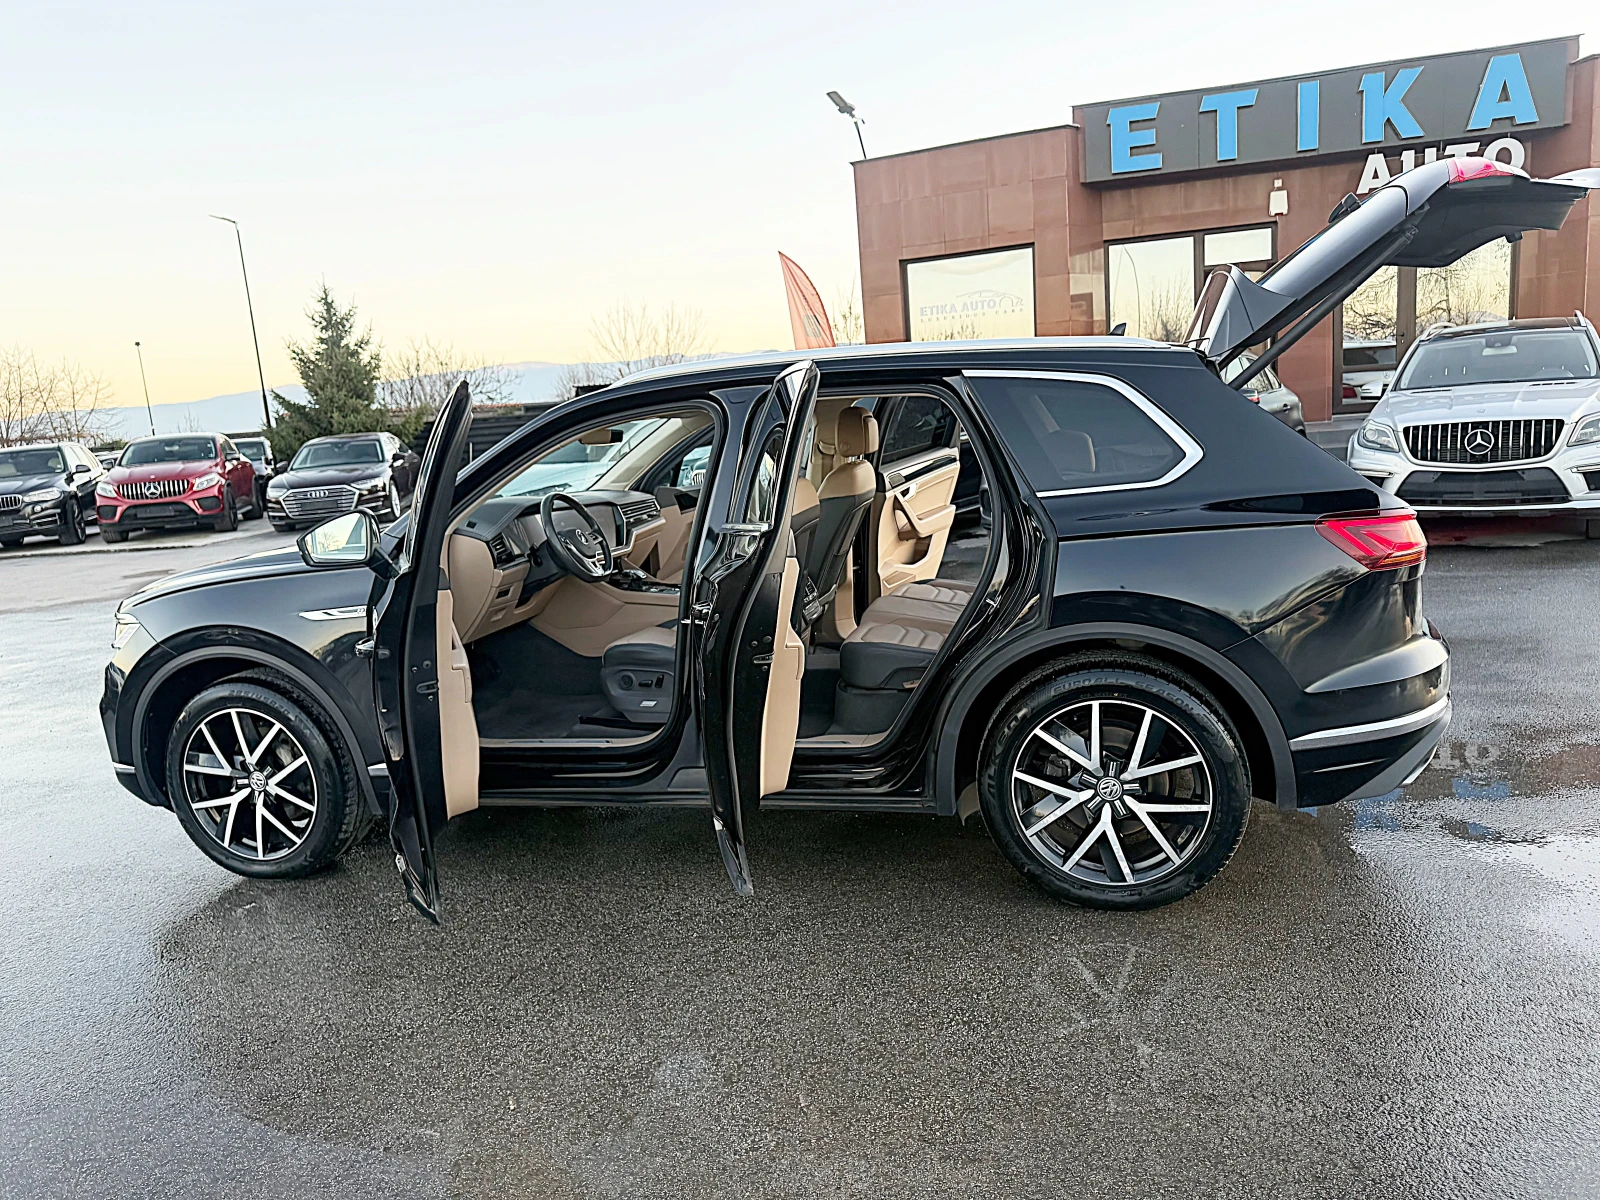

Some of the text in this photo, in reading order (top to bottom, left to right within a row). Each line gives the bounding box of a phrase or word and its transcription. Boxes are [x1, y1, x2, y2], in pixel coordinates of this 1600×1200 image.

[1106, 52, 1540, 174] ETIKA
[920, 299, 996, 316] ETIKA AUTO
[995, 307, 1023, 315] CARS
